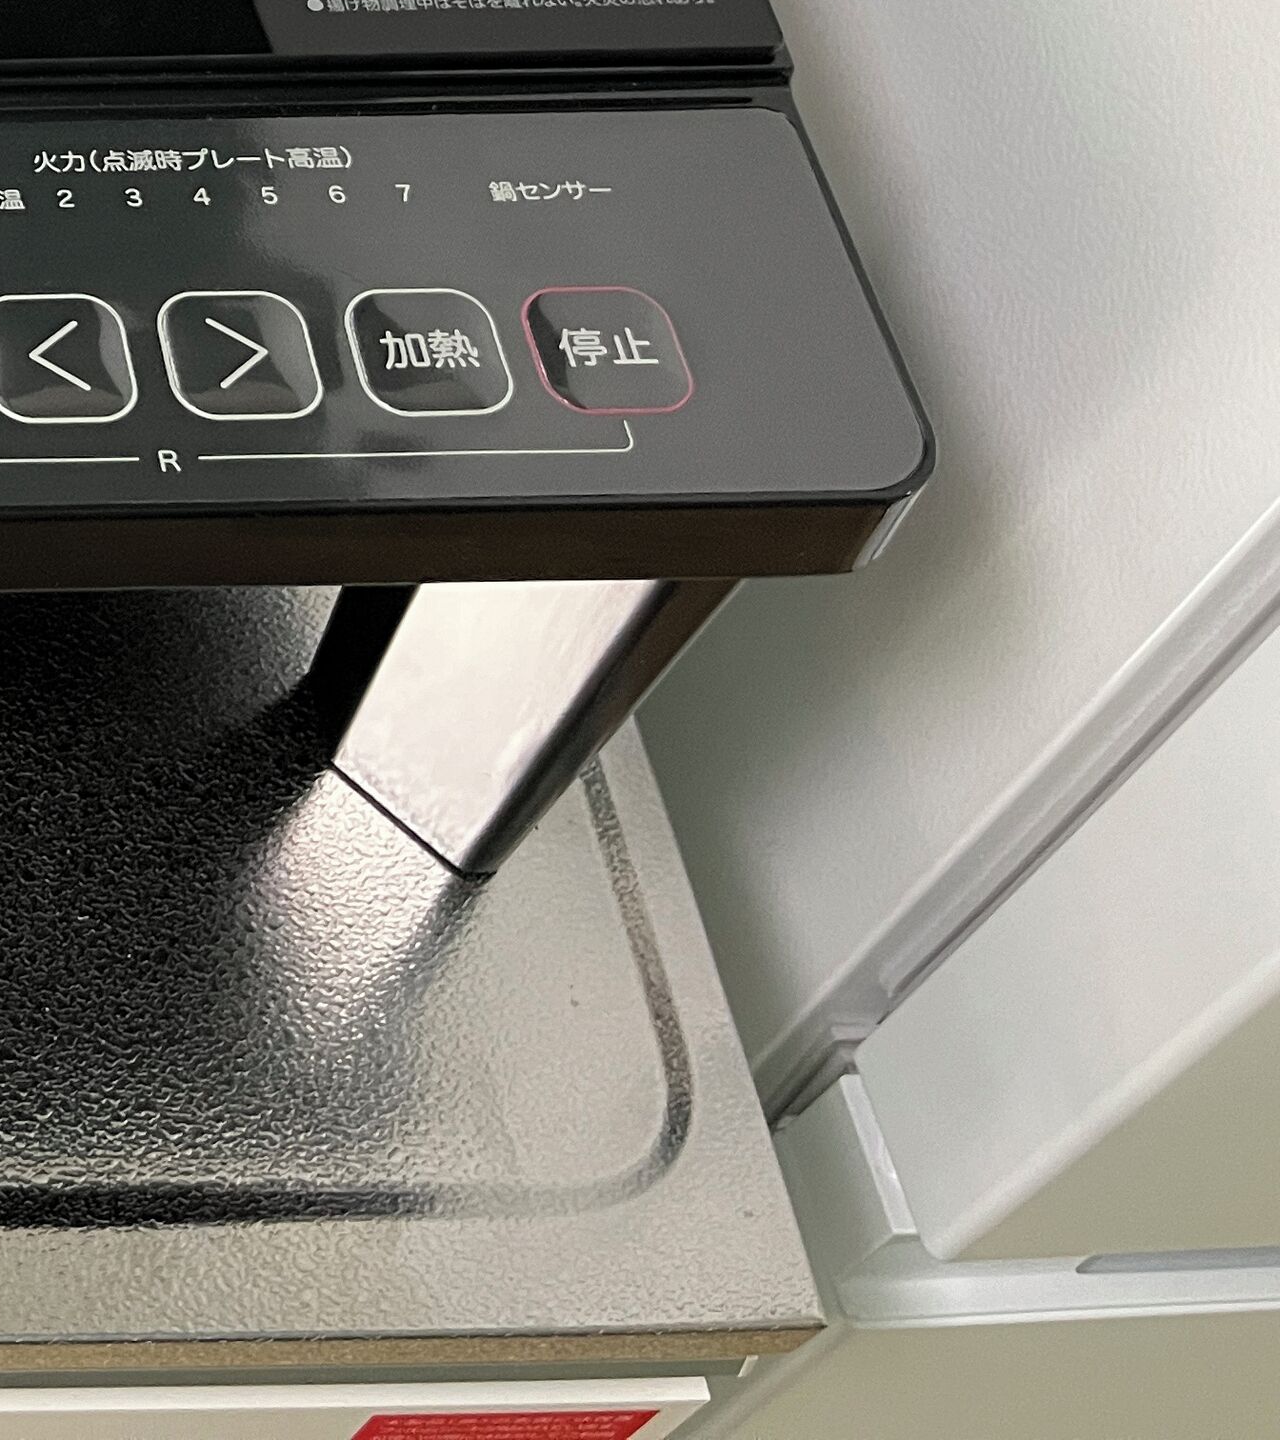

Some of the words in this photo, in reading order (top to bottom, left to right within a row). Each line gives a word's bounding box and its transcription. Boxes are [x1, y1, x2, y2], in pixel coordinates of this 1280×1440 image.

[33, 146, 353, 173] 火力(点滅時プレート高温)
[57, 190, 75, 207] 2
[125, 189, 143, 206] 3
[193, 188, 211, 205] 4
[261, 186, 278, 204] 5
[328, 185, 346, 203] 6
[395, 184, 411, 202] 7
[488, 181, 612, 202] 鍋センサー
[378, 327, 481, 370] 加熱
[559, 326, 659, 368] 停止
[158, 449, 181, 473] R
